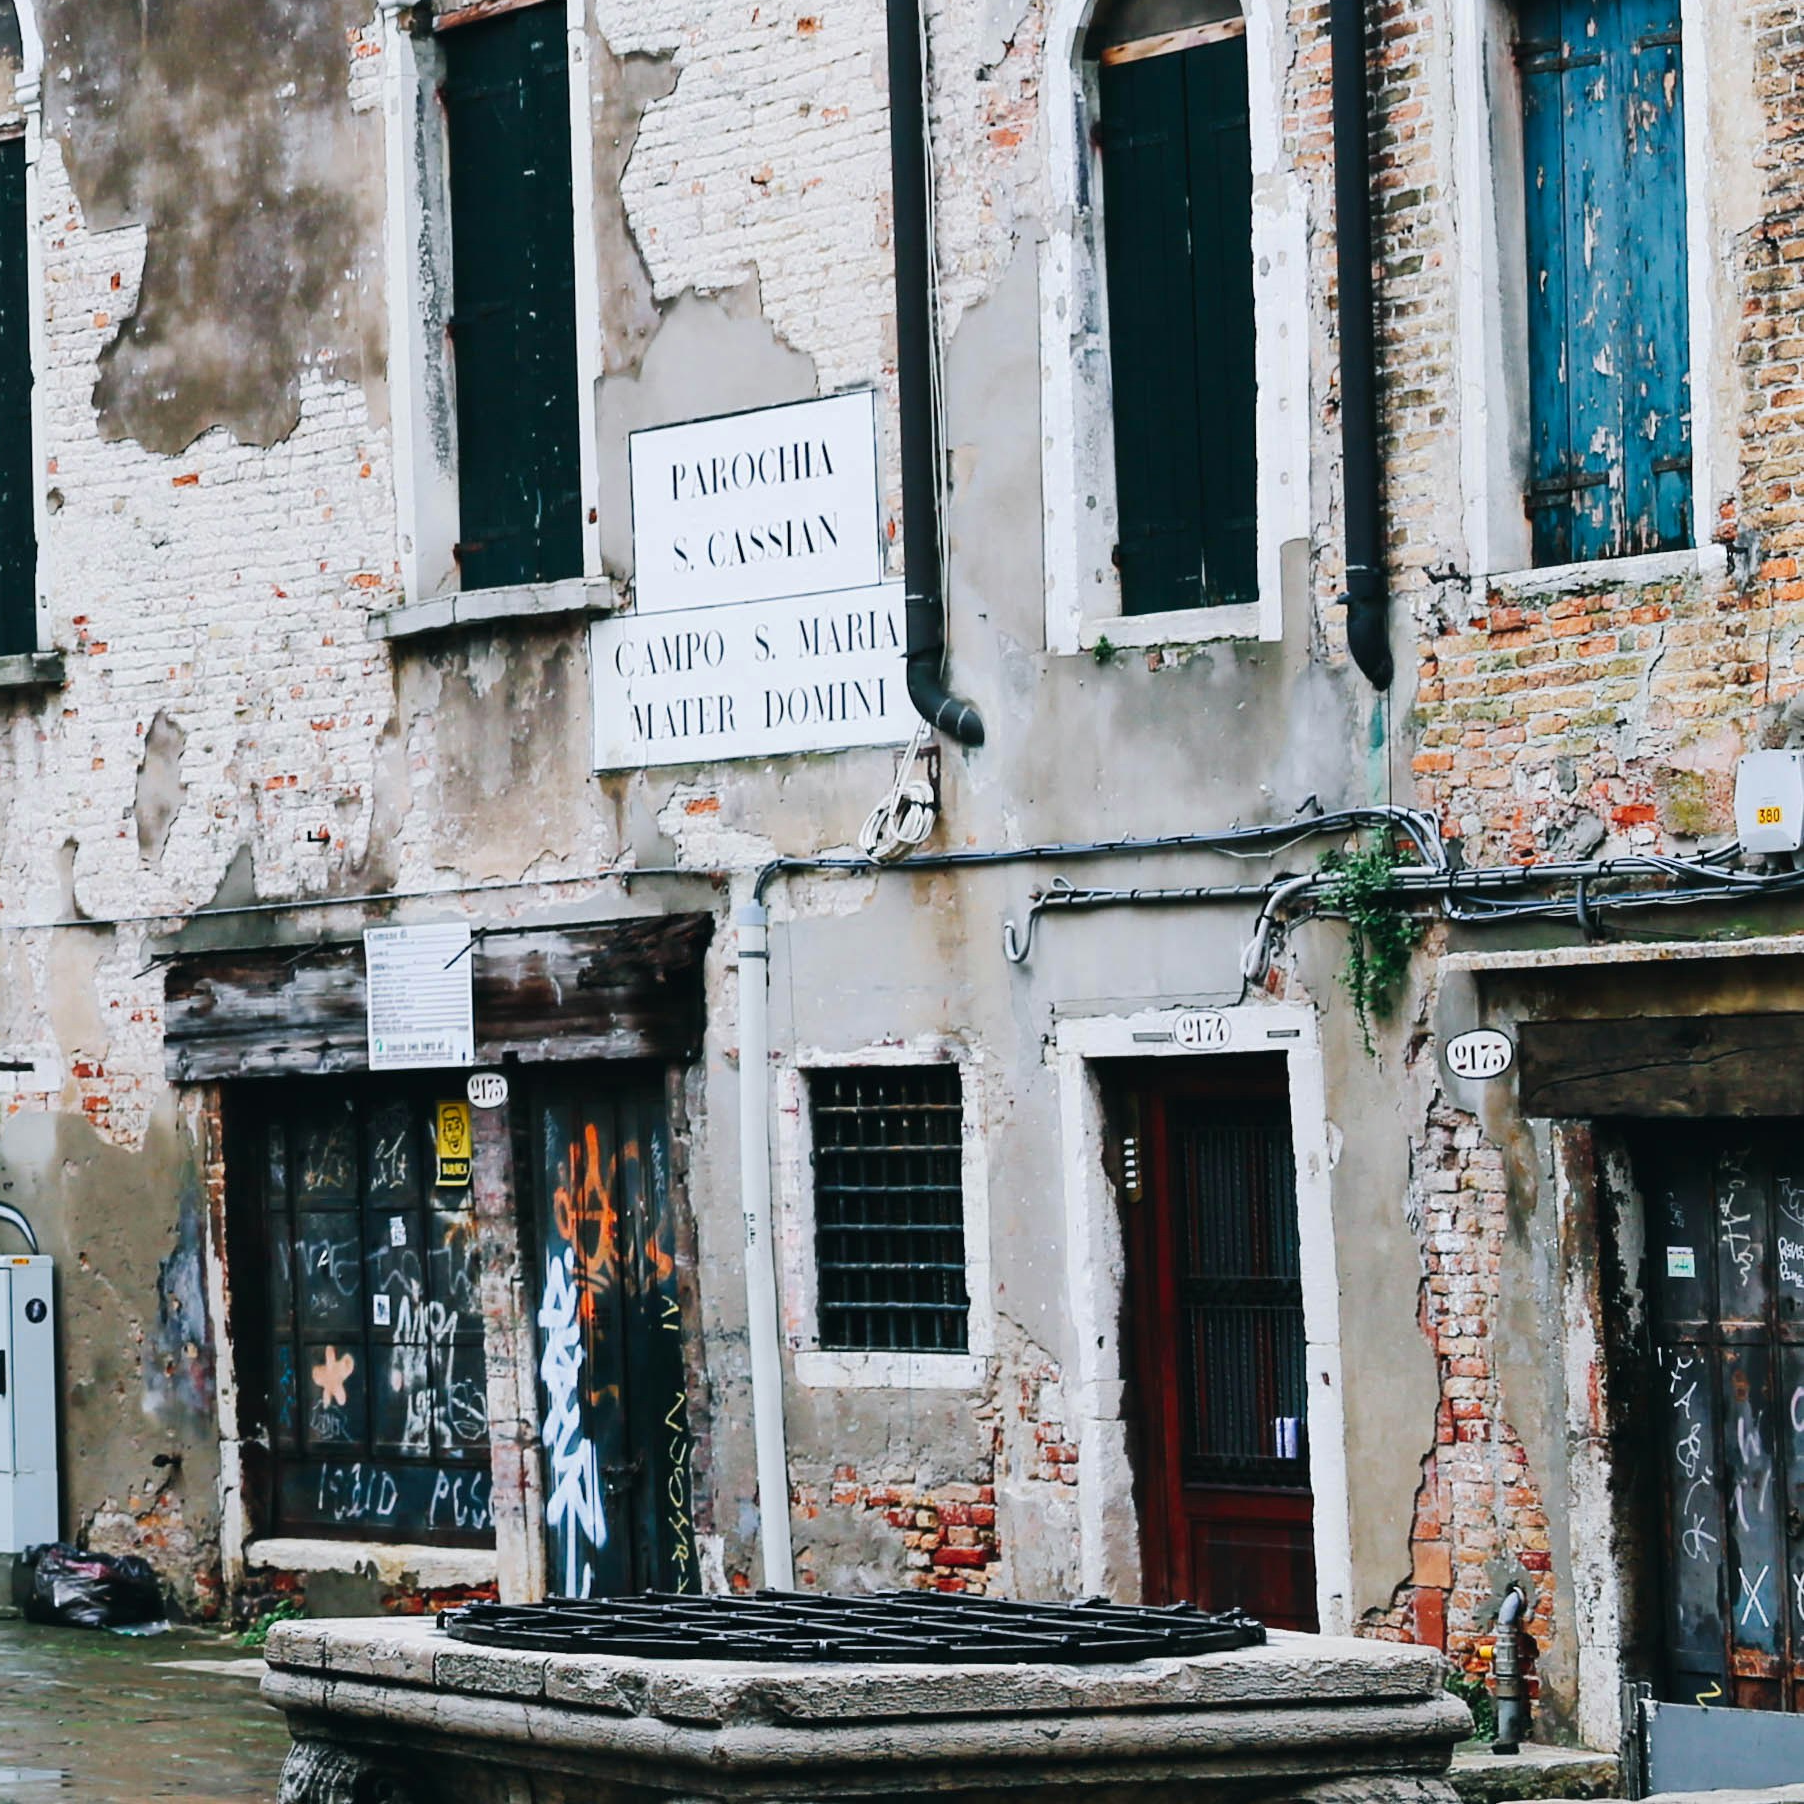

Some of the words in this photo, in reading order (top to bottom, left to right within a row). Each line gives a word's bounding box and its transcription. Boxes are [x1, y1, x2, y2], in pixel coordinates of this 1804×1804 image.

[671, 438, 834, 500] PAROCHIA
[672, 535, 695, 573] S.
[708, 511, 839, 569] CASSIAN
[614, 628, 724, 678] CAMPO
[754, 623, 777, 663] S.
[798, 608, 900, 658] MARIA
[631, 693, 737, 742] MATER
[763, 677, 887, 729] DOMINI
[1759, 807, 1780, 824] 380
[1182, 1017, 1225, 1043] 2174
